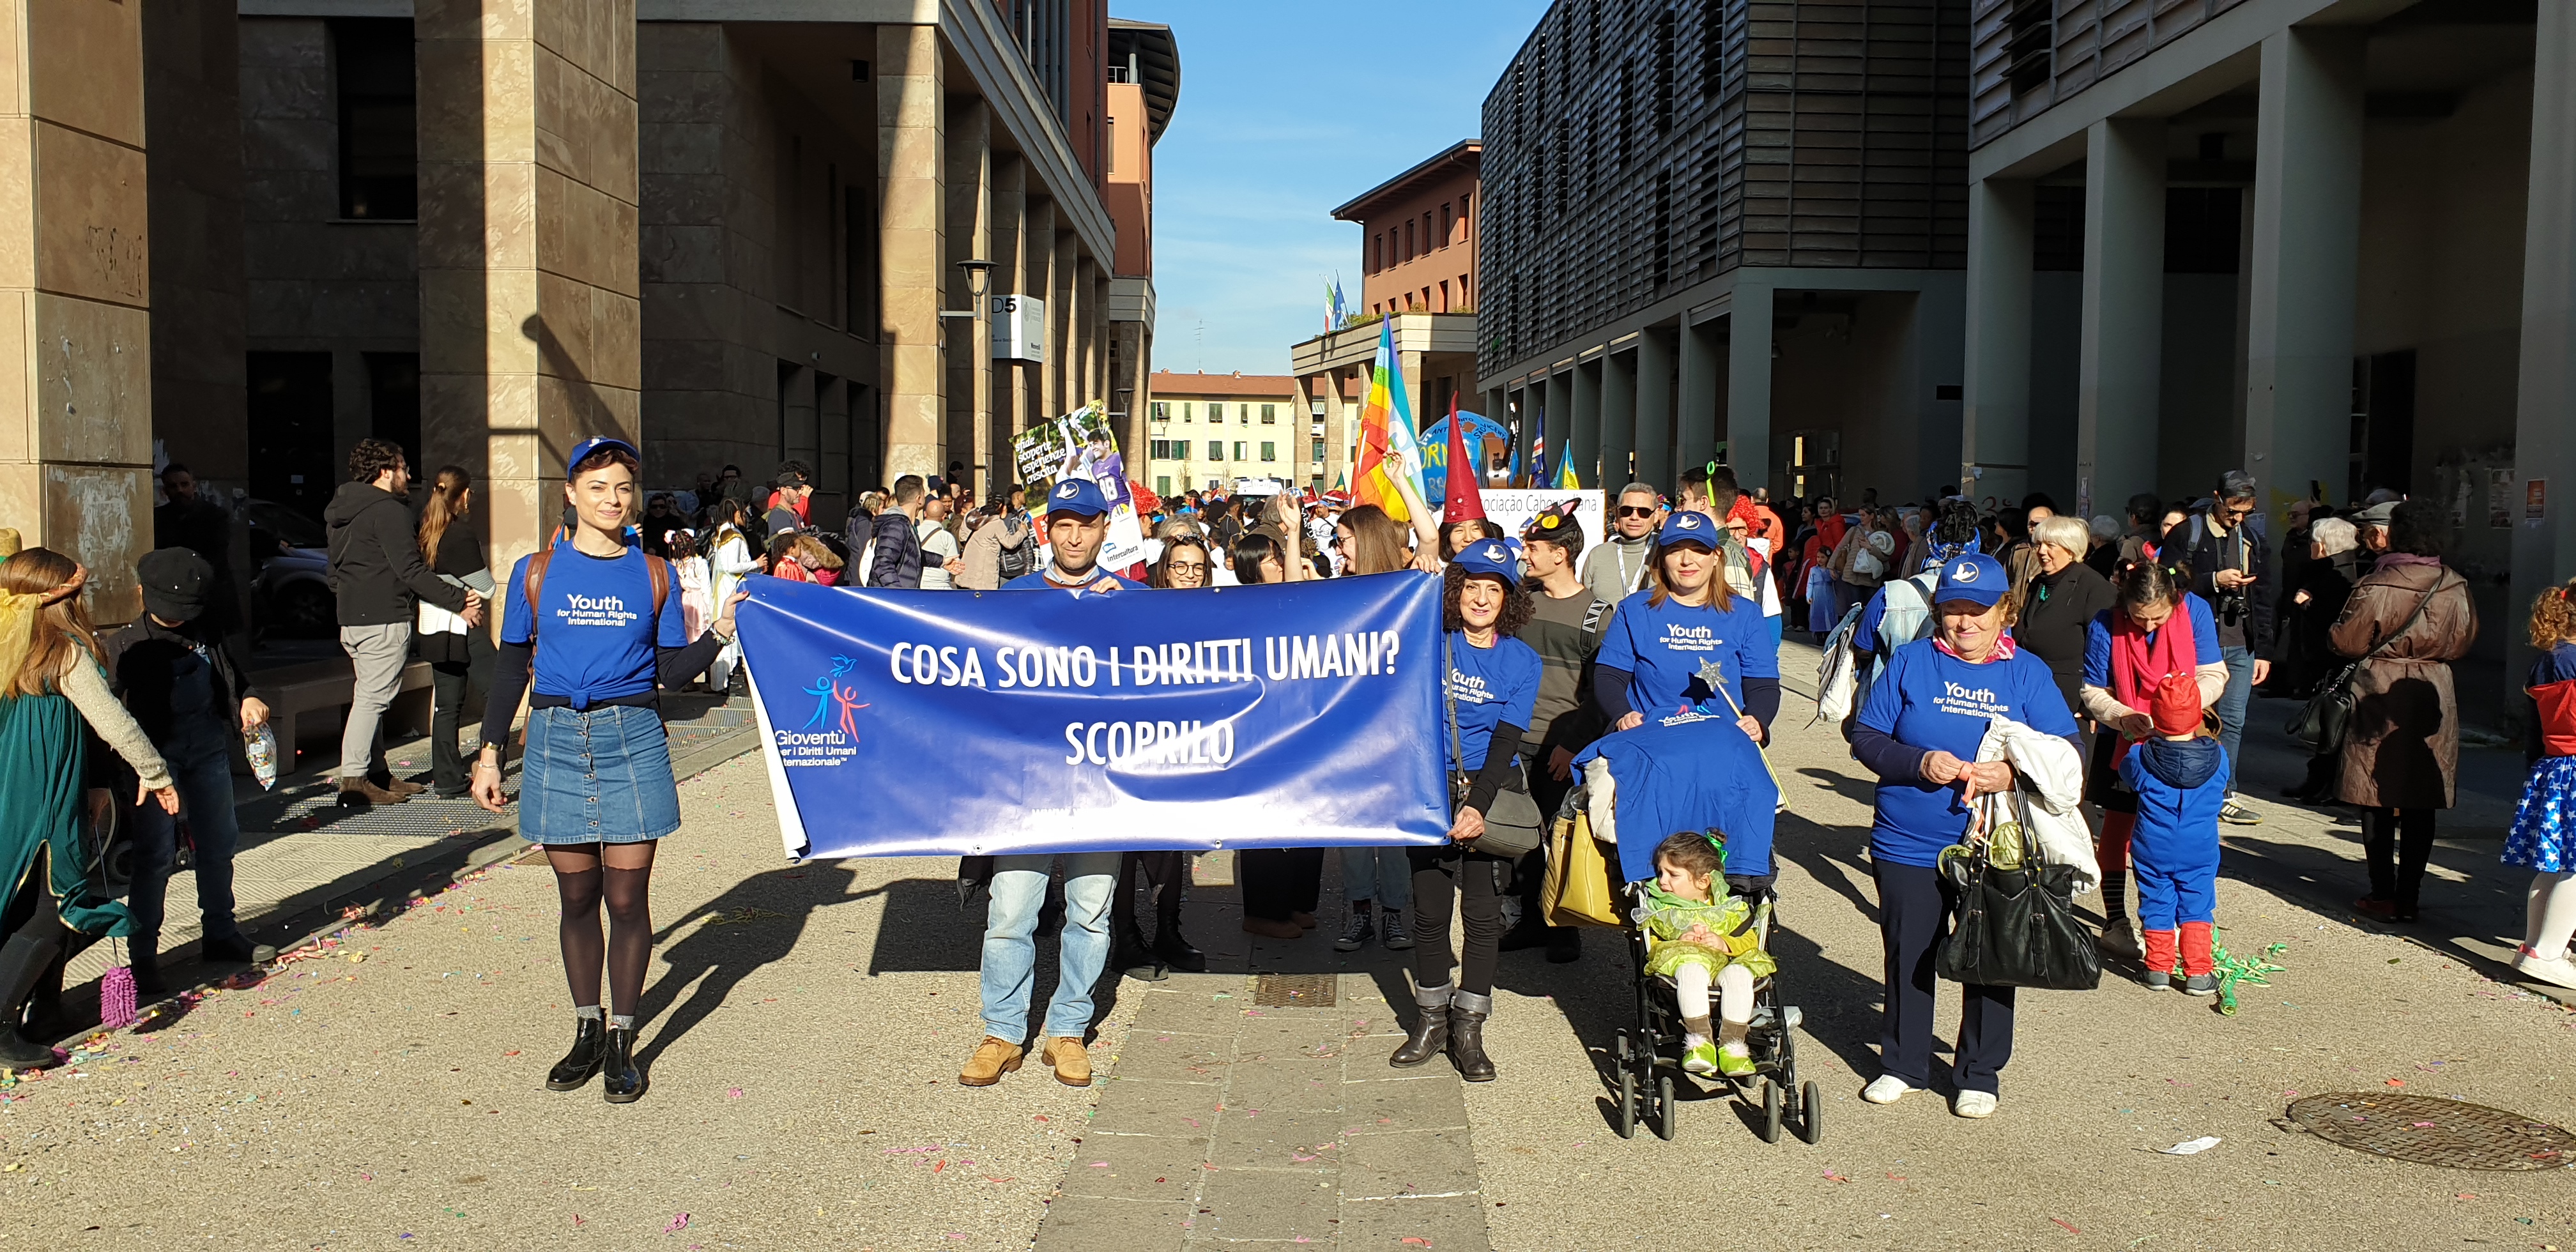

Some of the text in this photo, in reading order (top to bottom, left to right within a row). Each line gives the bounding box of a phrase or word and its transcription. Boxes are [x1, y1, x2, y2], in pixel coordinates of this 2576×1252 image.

[992, 298, 1017, 314] D5
[1015, 436, 1035, 454] sfide
[1018, 441, 1052, 466] scoperte
[1022, 448, 1066, 474] esperienze
[1026, 464, 1058, 485] crescita
[1482, 493, 1522, 516] ociação
[1107, 546, 1138, 563] Intercultura
[567, 593, 623, 611] Youth
[557, 609, 638, 620] for Human Rights
[567, 616, 626, 627] International
[1666, 623, 1712, 639] Youth
[1668, 643, 1713, 651] International
[1671, 637, 1697, 645] Human
[891, 630, 1400, 688] COSA SONO I DIRITTI UMANI?
[1469, 688, 1494, 699] Rights
[1943, 681, 1995, 703] Youth
[1933, 696, 2009, 713] for Human Rights
[774, 729, 846, 745] Gioventù
[1065, 719, 1234, 765] SCOPRILO
[793, 747, 796, 756] i
[799, 746, 824, 756] Diritti
[826, 746, 857, 756] Umani
